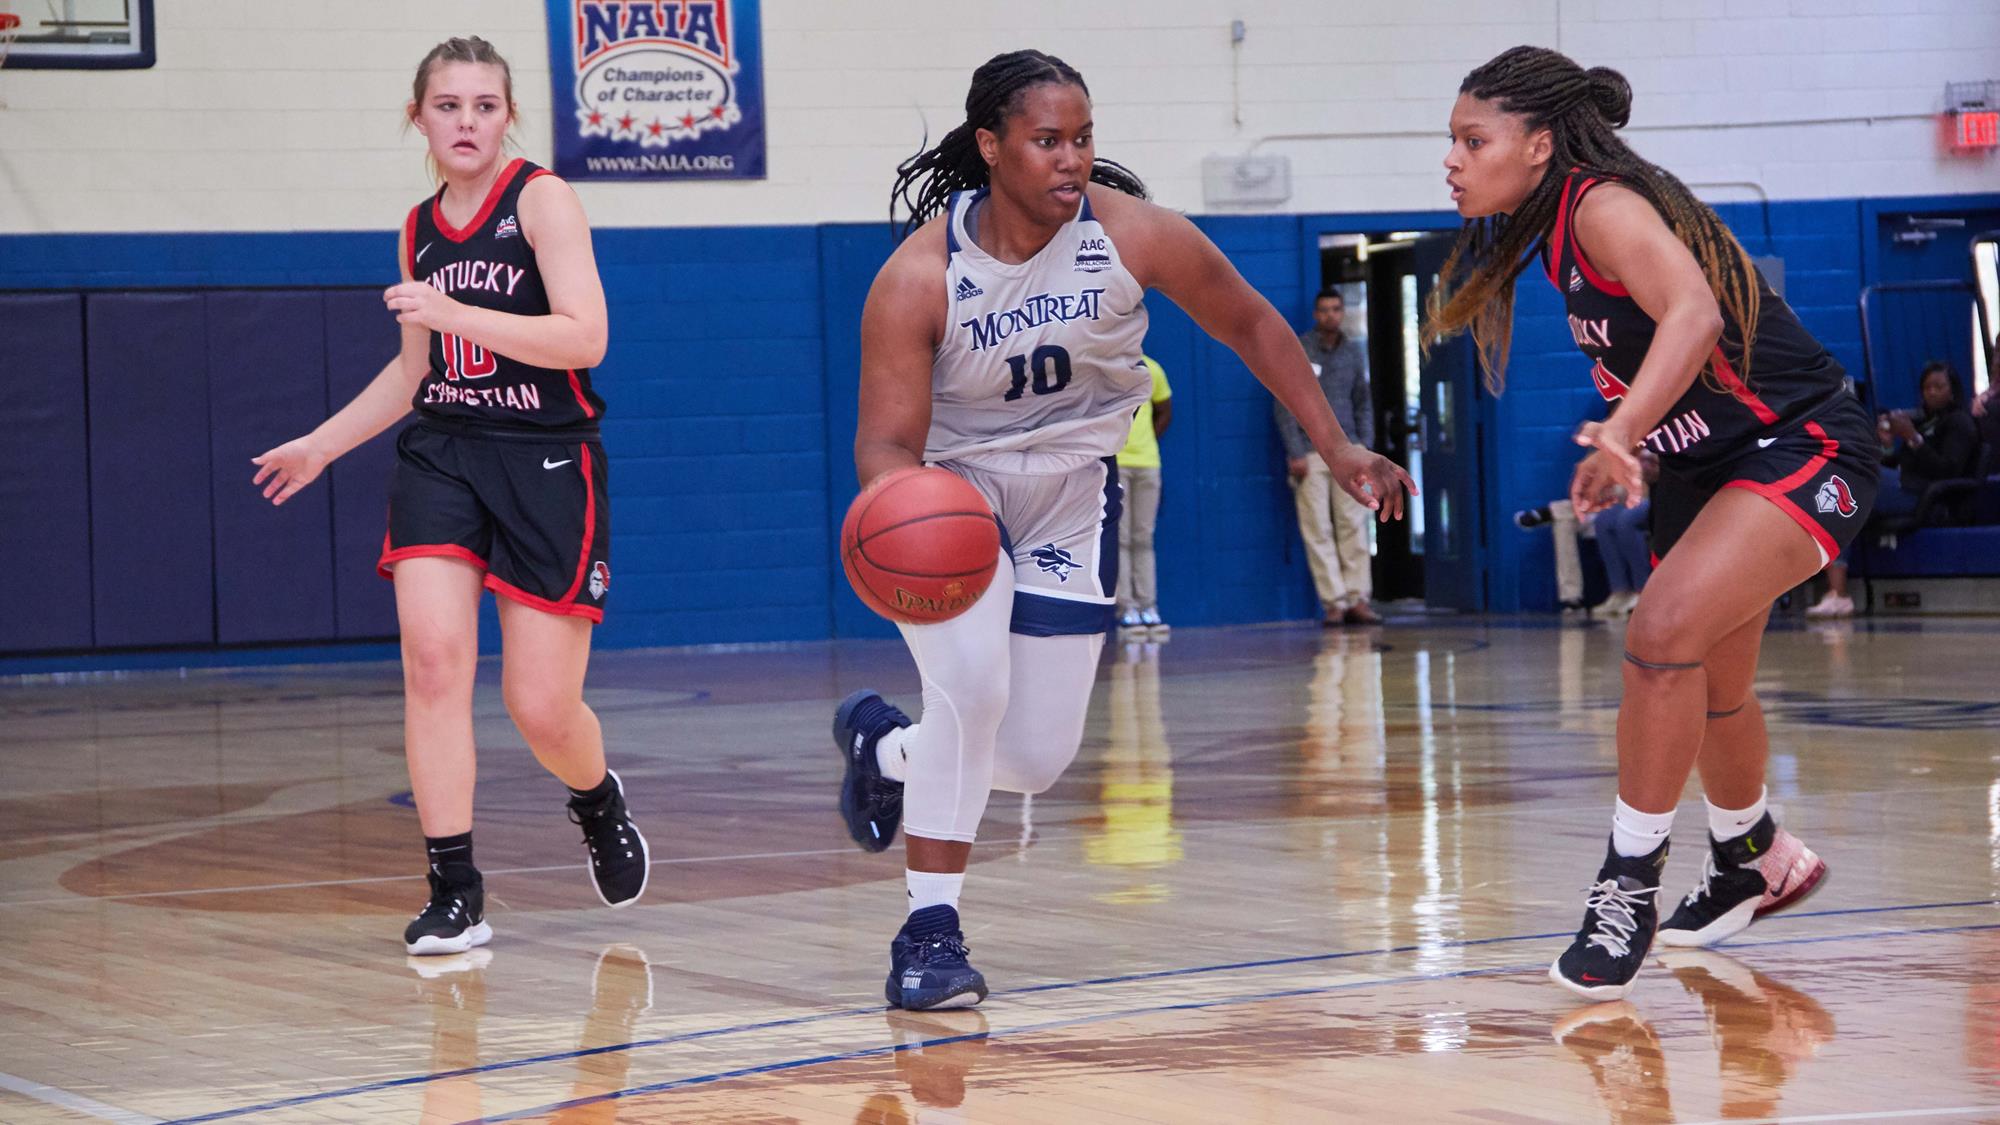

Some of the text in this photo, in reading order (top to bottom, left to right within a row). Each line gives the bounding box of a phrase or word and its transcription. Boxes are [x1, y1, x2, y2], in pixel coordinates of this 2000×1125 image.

[583, 3, 724, 57] NAIA
[603, 68, 705, 84] Champions
[597, 88, 713, 101] of Character
[1080, 238, 1105, 251] AAC
[425, 260, 525, 296] NTUCKY
[1004, 344, 1073, 402] 10
